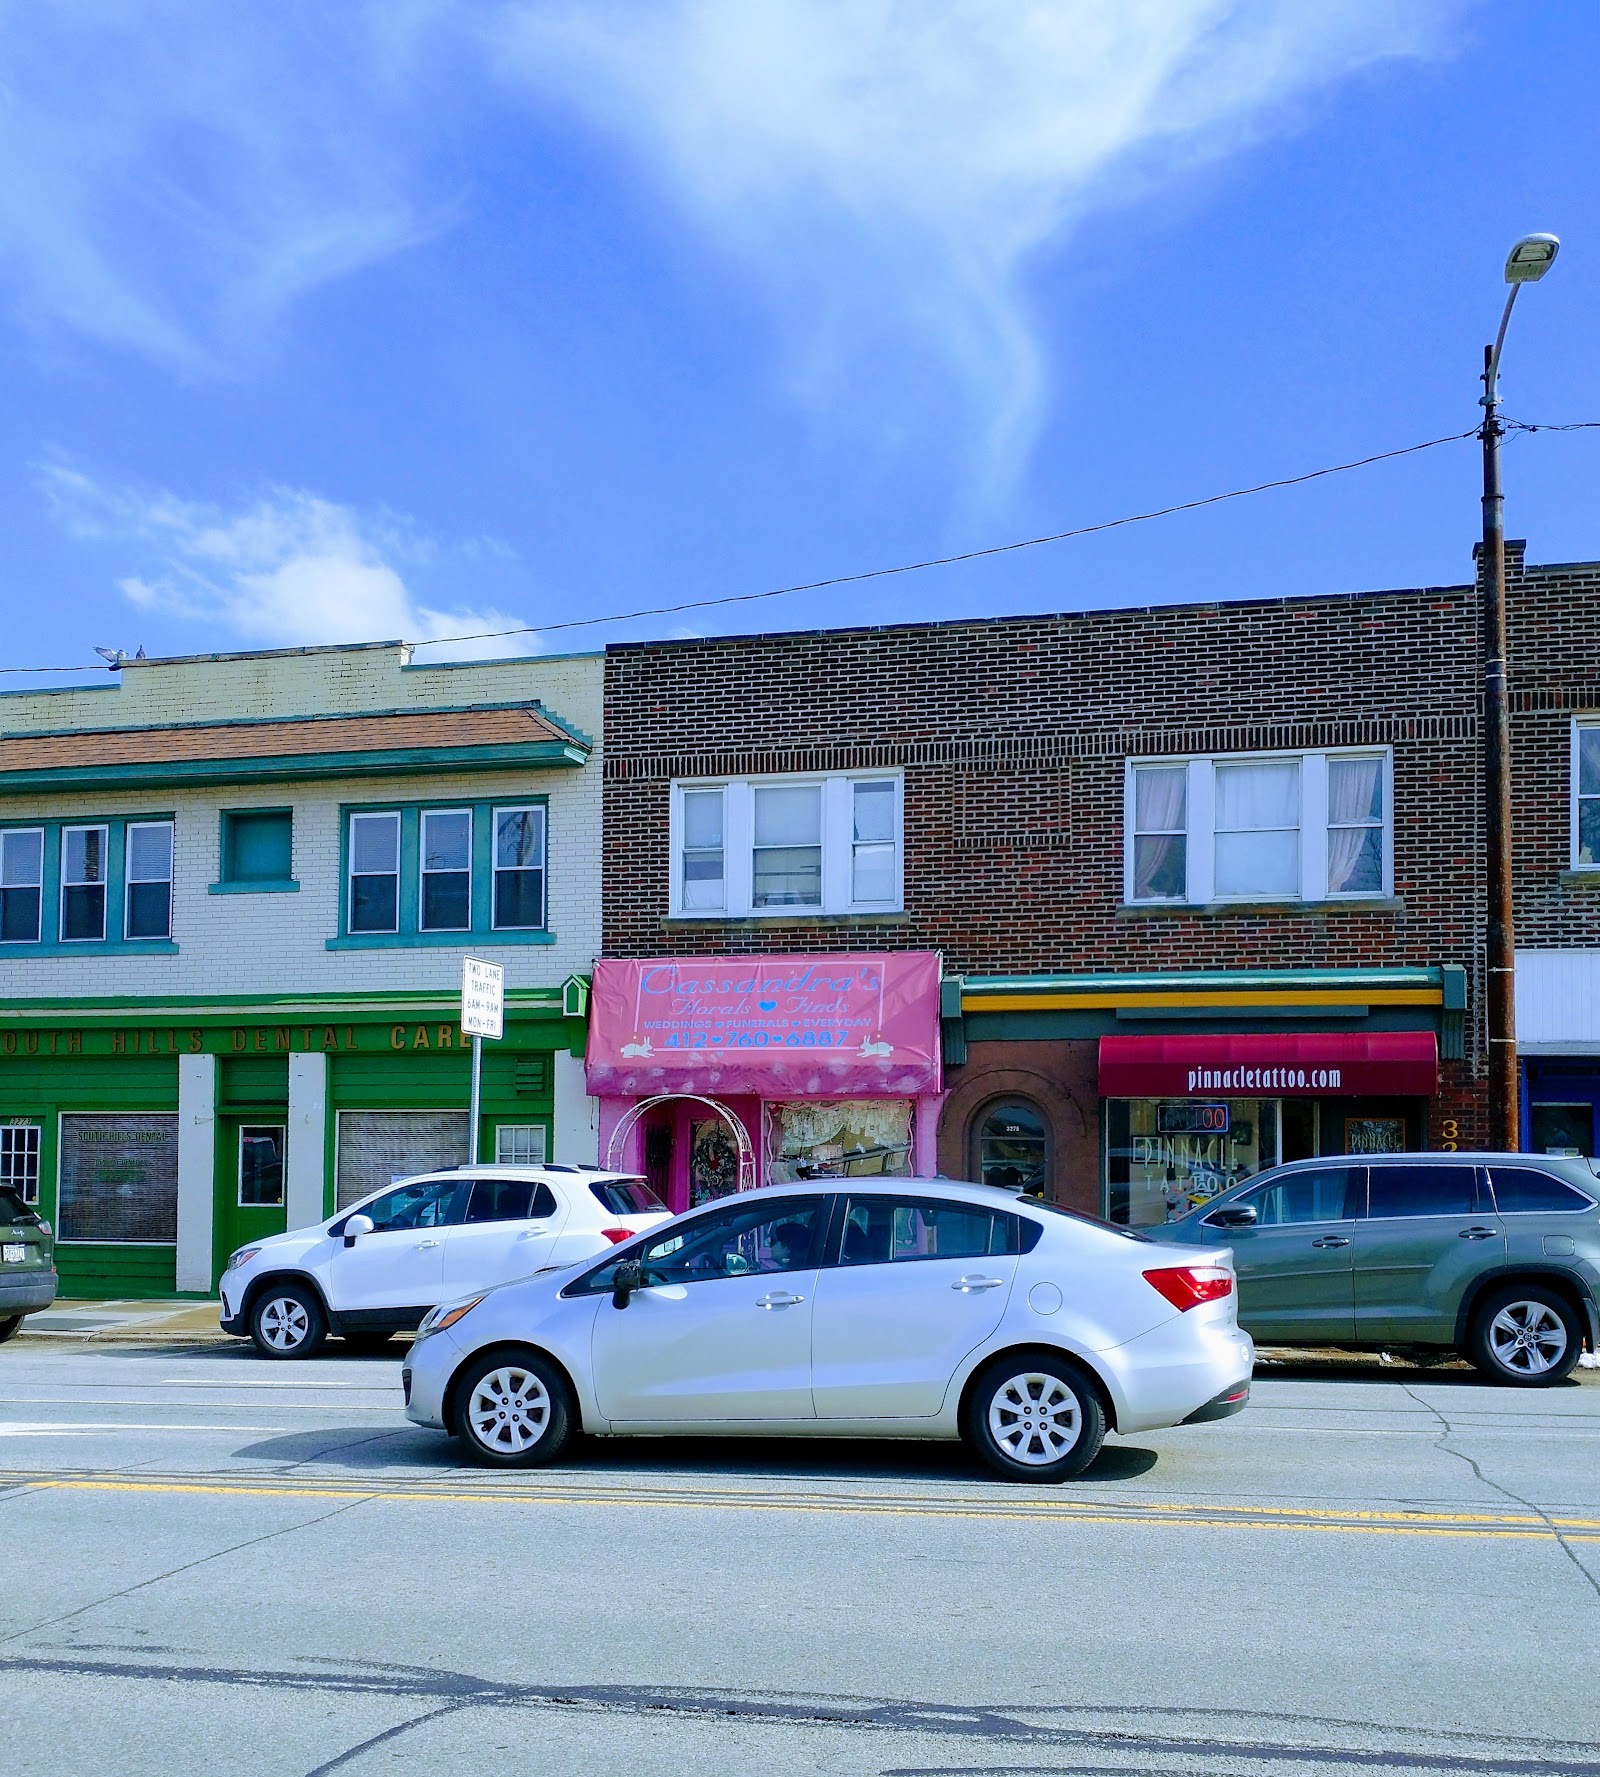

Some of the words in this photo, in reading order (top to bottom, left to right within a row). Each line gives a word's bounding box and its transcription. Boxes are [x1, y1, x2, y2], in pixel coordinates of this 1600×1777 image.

[468, 962, 481, 976] TWO
[485, 966, 500, 981] LANE
[641, 963, 881, 995] Cassandra's
[471, 980, 496, 996] TRAFFIC
[668, 997, 751, 1016] Florals
[783, 995, 849, 1014] Finds
[467, 1015, 497, 1031] MON-FRI
[643, 1019, 713, 1030] WEDDINGS
[726, 1018, 789, 1029] FUNERALS
[803, 1017, 872, 1028] EVERYDAY
[111, 1029, 203, 1053] HILLS
[231, 1027, 359, 1051] DENTAL
[390, 1025, 474, 1050] CARE
[664, 1031, 709, 1049] 412
[725, 1030, 770, 1048] 760
[785, 1030, 849, 1048] 6887
[1187, 1065, 1342, 1092] pinnacletattoo.com
[1144, 1136, 1238, 1171] PINNACLE
[1144, 1174, 1238, 1193] TATTOO
